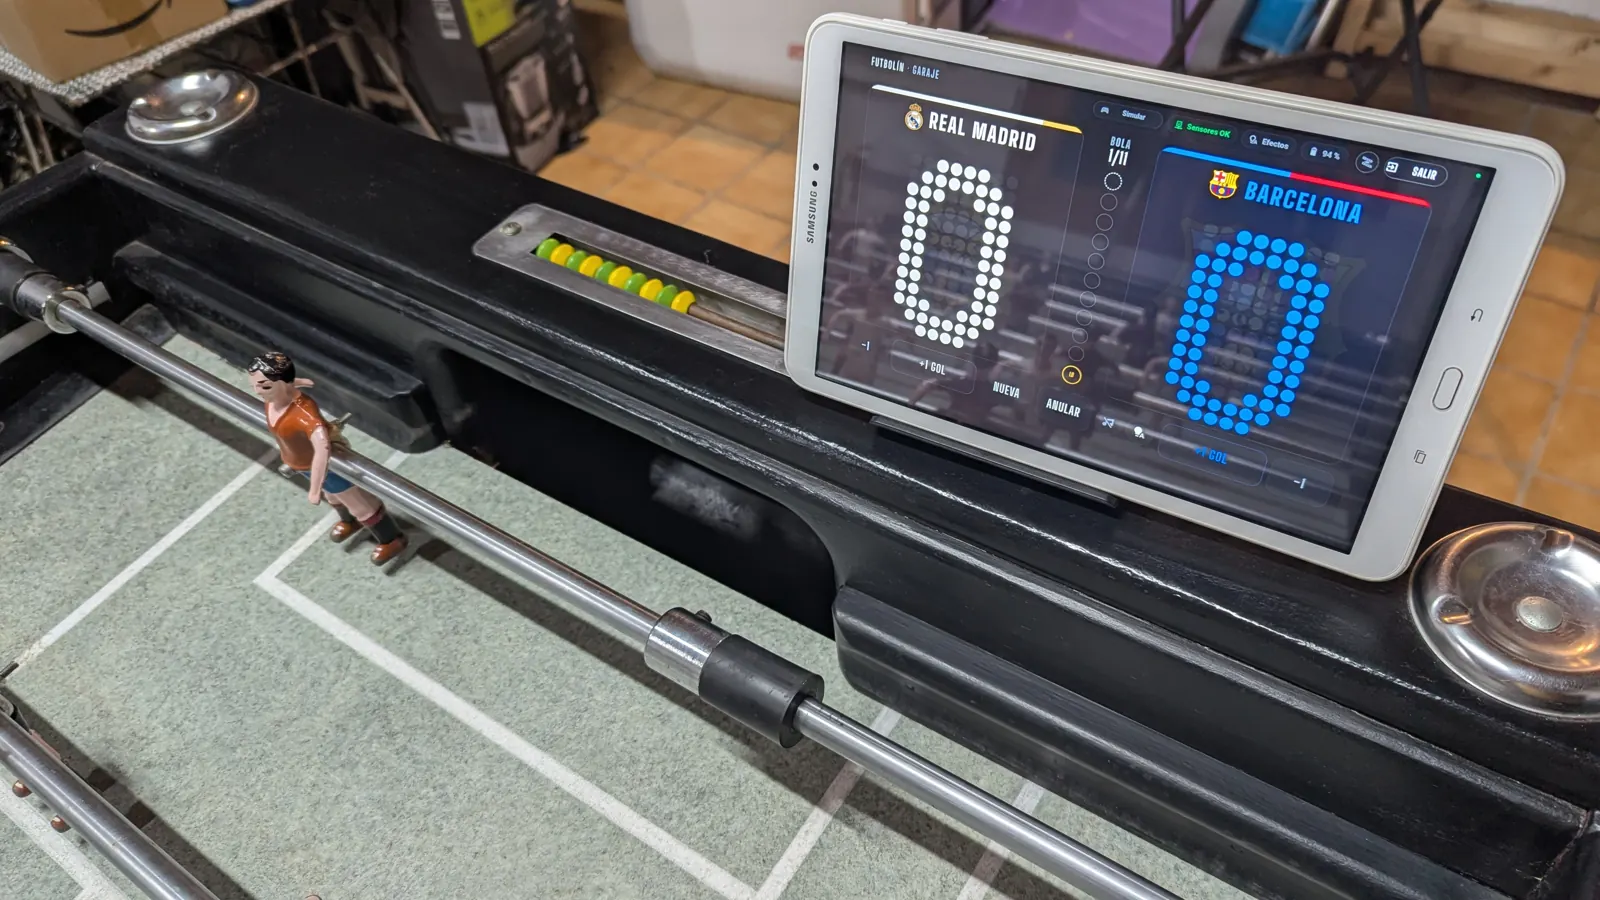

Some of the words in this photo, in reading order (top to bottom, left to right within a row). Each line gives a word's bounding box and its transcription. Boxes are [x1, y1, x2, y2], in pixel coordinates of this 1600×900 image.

[871, 56, 905, 72] FUTBOLÍN
[912, 65, 940, 80] GARAJE
[1122, 109, 1146, 121] Simular
[928, 111, 966, 137] REAL
[971, 120, 1037, 152] MADRID
[1186, 122, 1219, 137] Sensores
[1219, 129, 1231, 139] OK
[1110, 136, 1131, 150] BOLA
[1261, 137, 1289, 150] Efectos
[1107, 148, 1129, 167] 1/11
[1322, 150, 1333, 159] 94
[1333, 152, 1341, 161] %
[1411, 166, 1438, 180] SALIR
[1244, 180, 1362, 224] BARCELONA
[806, 191, 818, 244] SAMSUNG
[893, 159, 1014, 349] 0
[1164, 230, 1330, 435] 0
[919, 359, 929, 370] +1
[930, 361, 946, 376] GOL
[992, 381, 1020, 399] NUEVA
[1046, 398, 1081, 418] ANULAR
[1194, 446, 1208, 458] +1
[1208, 449, 1228, 465] GOL
